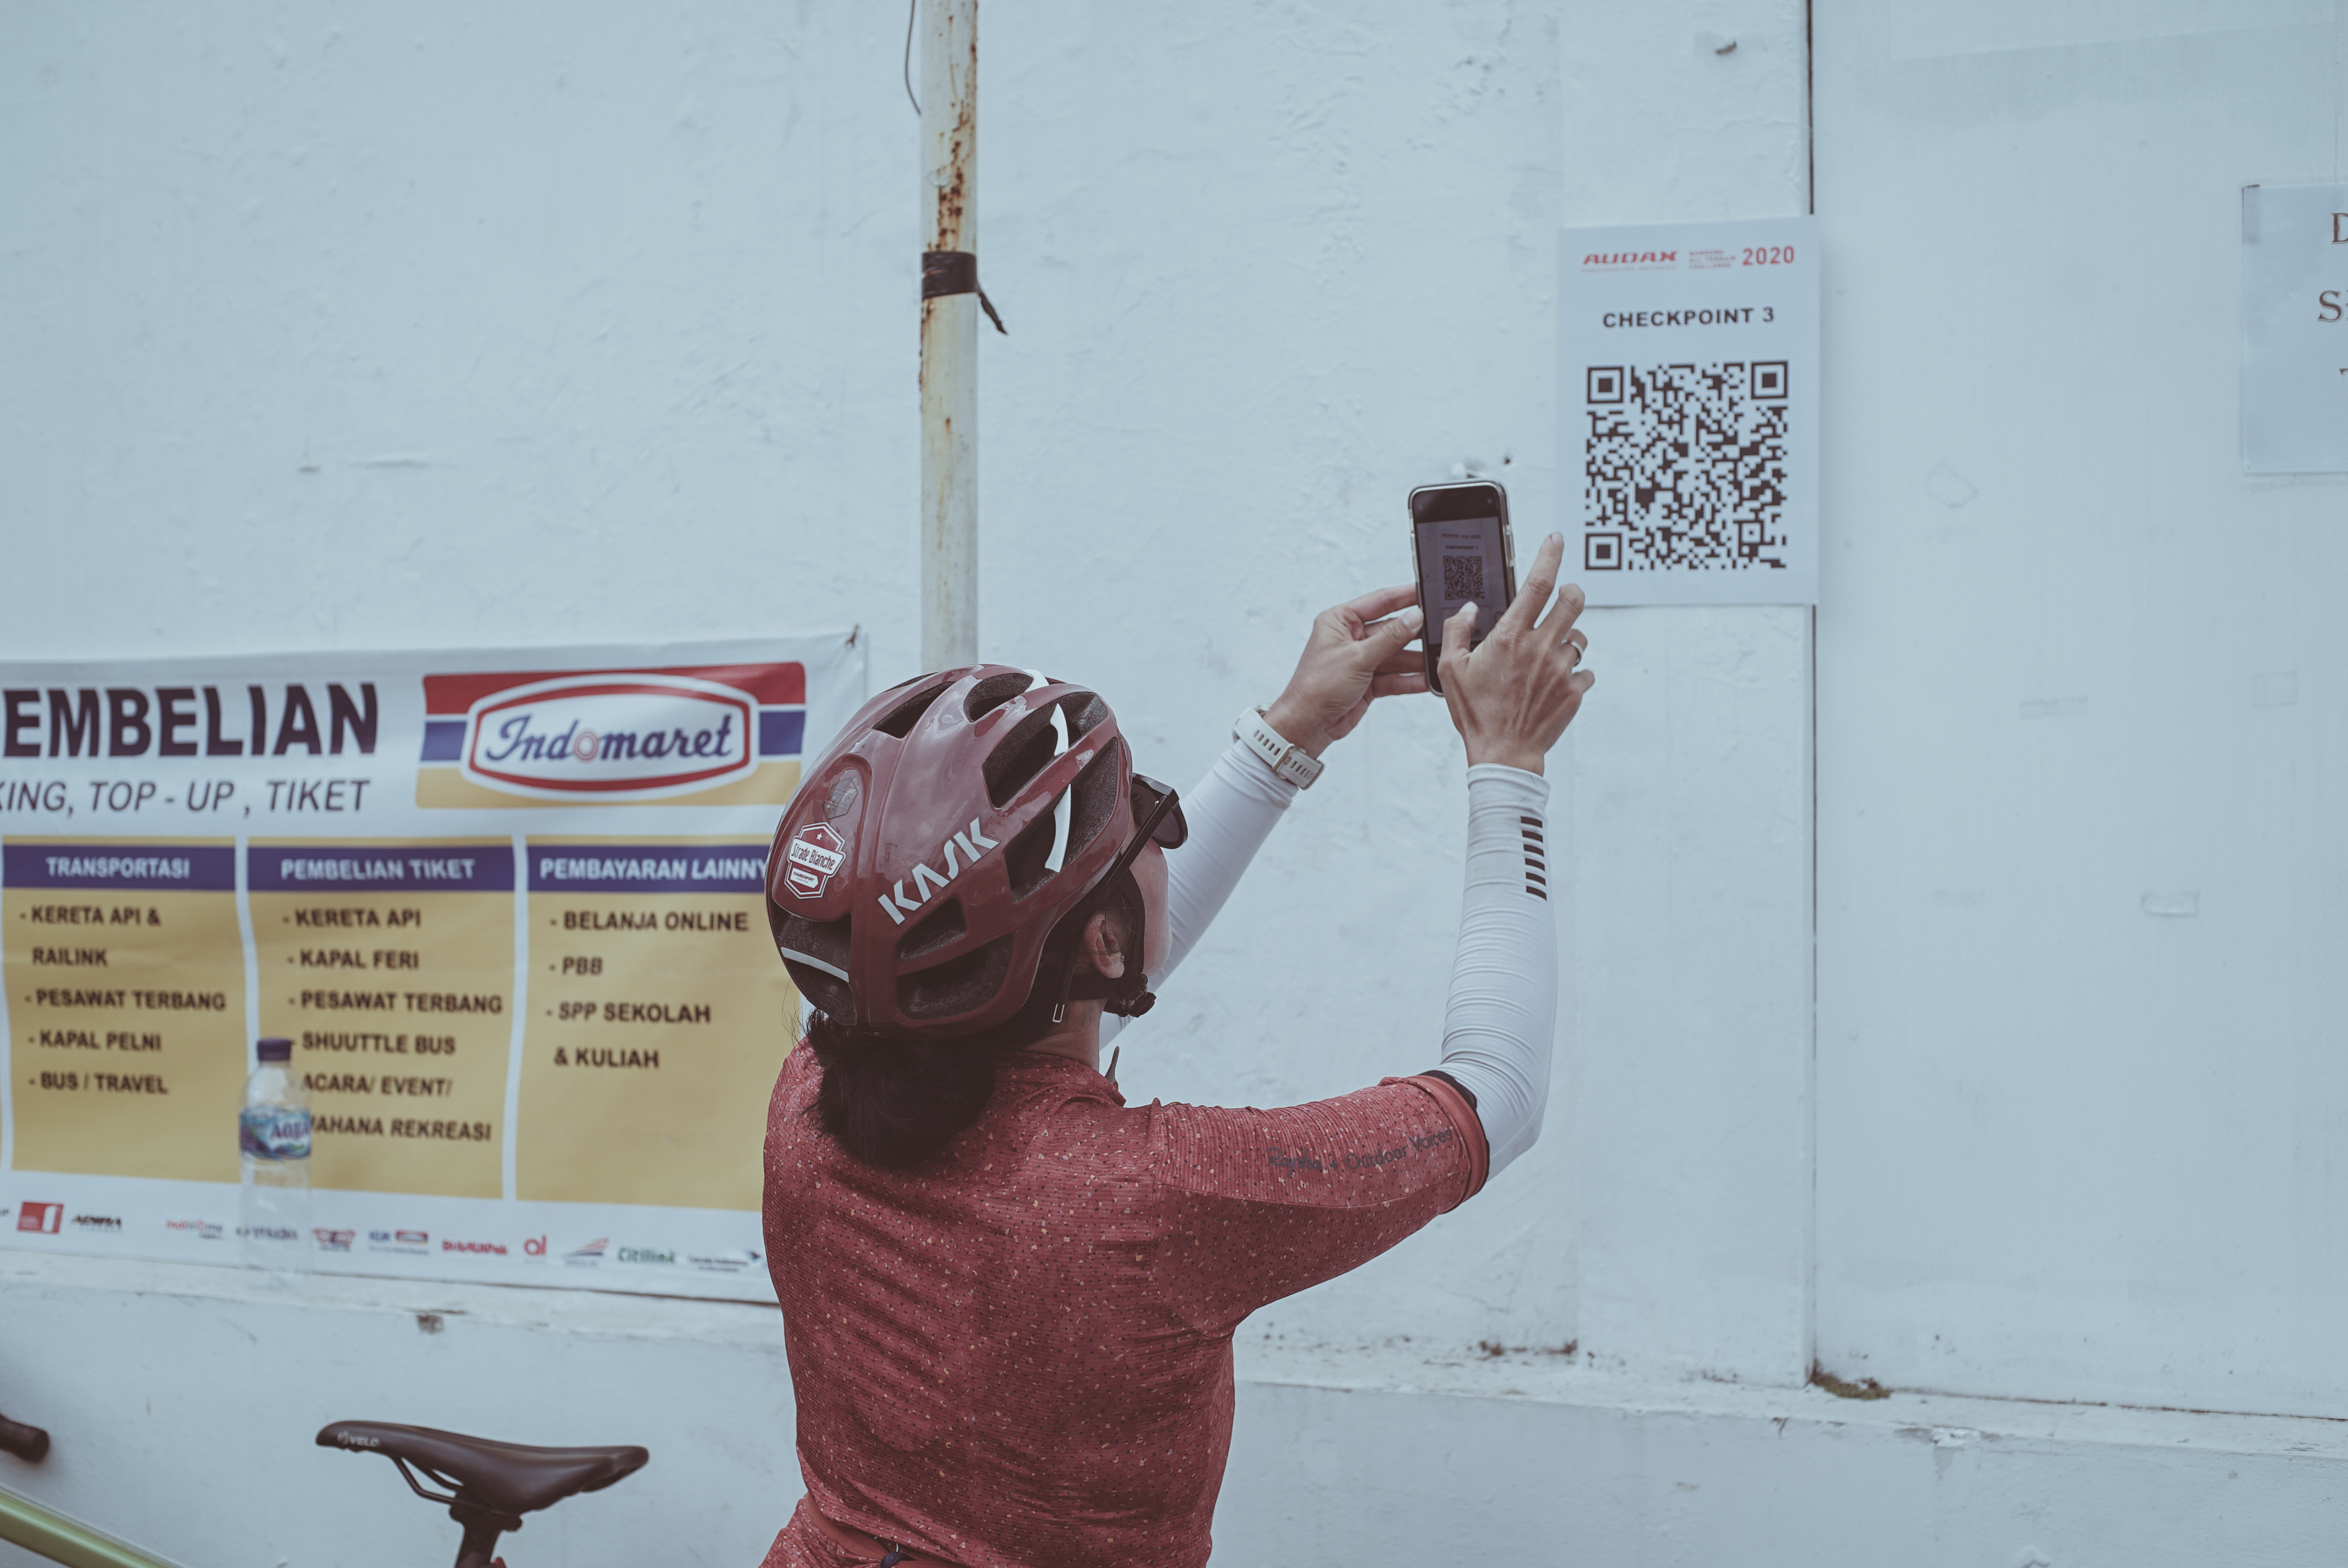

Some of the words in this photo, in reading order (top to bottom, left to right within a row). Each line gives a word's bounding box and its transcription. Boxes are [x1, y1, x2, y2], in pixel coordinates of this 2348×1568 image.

[1583, 251, 1677, 265] AUDAX
[1742, 245, 1794, 266] 2020
[1603, 308, 1754, 328] CHECKPOINT
[1763, 306, 1774, 323] 3
[2317, 290, 2348, 323] S
[2, 682, 378, 758] EMBELIAN
[486, 713, 732, 761] Indomaret
[0, 781, 74, 816] ING,
[90, 781, 157, 812] TOP
[187, 781, 234, 812] UP
[268, 780, 370, 812] TIKET
[791, 843, 810, 862] Strade
[46, 857, 190, 879] TRANSPORTASI
[281, 859, 404, 880] PEMBELIAN
[409, 858, 475, 879] TIKET
[540, 858, 688, 880] PEMBAYARAN
[877, 817, 1000, 925] KASK
[32, 905, 104, 925] KERETA
[110, 907, 141, 925] API
[147, 907, 161, 926] &
[294, 908, 380, 927] KERETA
[386, 908, 421, 927] API
[564, 910, 657, 931] BELANJA
[665, 912, 749, 932] ONLINE
[32, 946, 108, 966] RAILINK
[300, 949, 366, 969] KAPAL
[373, 950, 419, 970] FERI
[562, 956, 603, 975] PBB
[35, 988, 126, 1008] PESAWAT
[131, 990, 226, 1011] TERBANG
[301, 990, 397, 1010] PESAWAT
[404, 992, 503, 1014] TERBANG
[558, 1001, 597, 1021] SPP
[604, 1002, 712, 1024] SEKOLAH
[40, 1029, 100, 1050] KAPAL
[106, 1031, 162, 1052] PELNI
[302, 1030, 407, 1054] SHUUTTLE
[414, 1035, 456, 1055] BUS
[554, 1047, 569, 1066] &
[575, 1048, 660, 1069] KULIAH
[40, 1071, 79, 1091] BUS
[94, 1073, 168, 1094] TRAVEL
[380, 1075, 453, 1096] EVENT/
[310, 1114, 384, 1136] AHANA
[390, 1118, 492, 1142] REKREASI
[1266, 1146, 1323, 1178] Rapha
[1345, 1146, 1407, 1170] Outdoor
[1408, 1129, 1453, 1151] Voices
